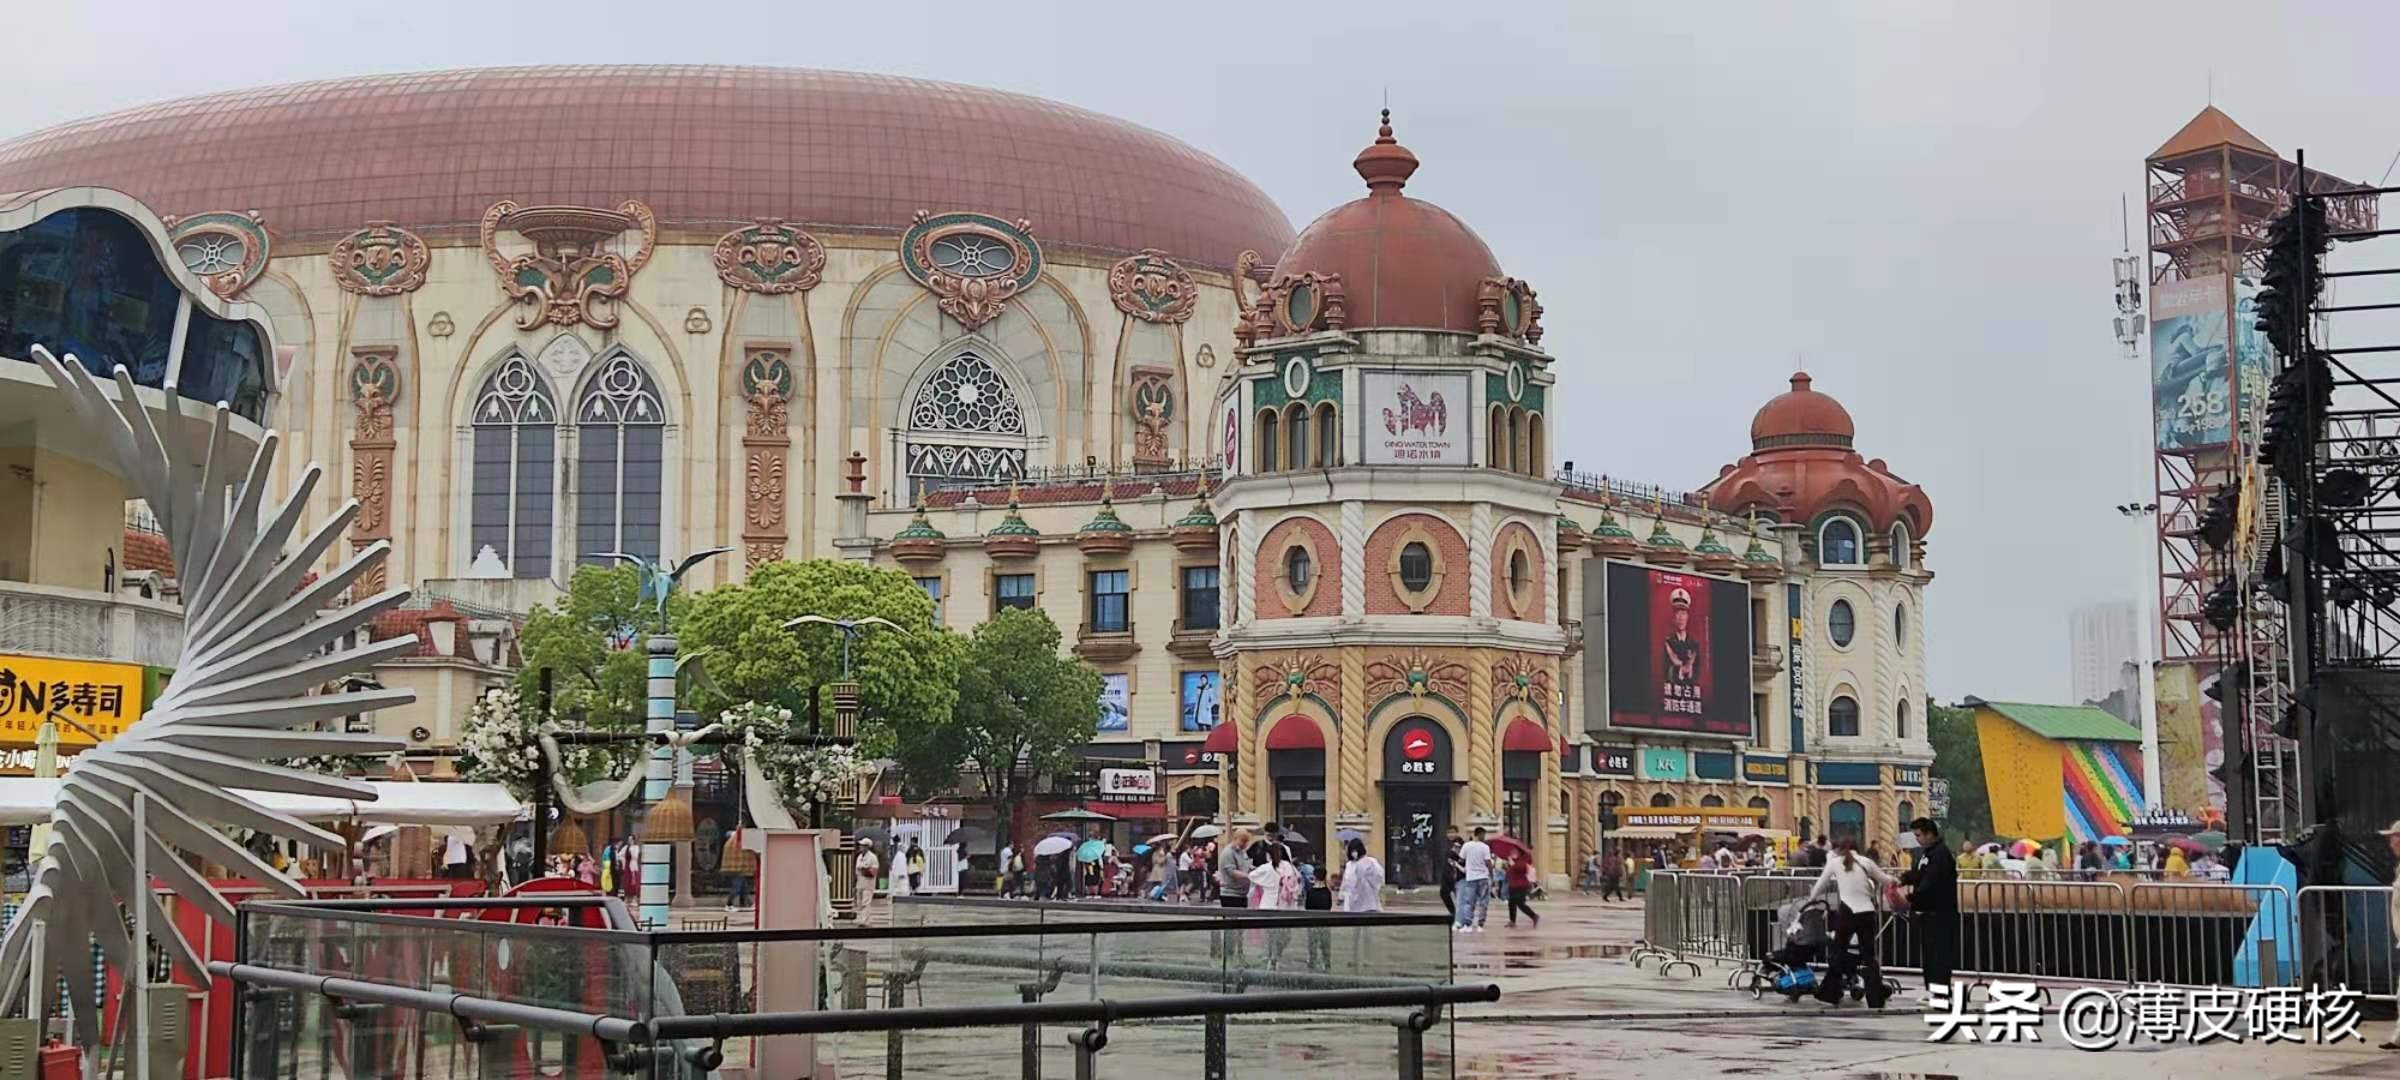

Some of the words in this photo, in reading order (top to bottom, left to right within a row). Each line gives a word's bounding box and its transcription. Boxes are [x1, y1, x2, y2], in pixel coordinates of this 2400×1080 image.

[19, 681, 123, 718] N多寿司
[1402, 761, 1435, 773] 必胜客
[1656, 758, 1677, 773] KFC
